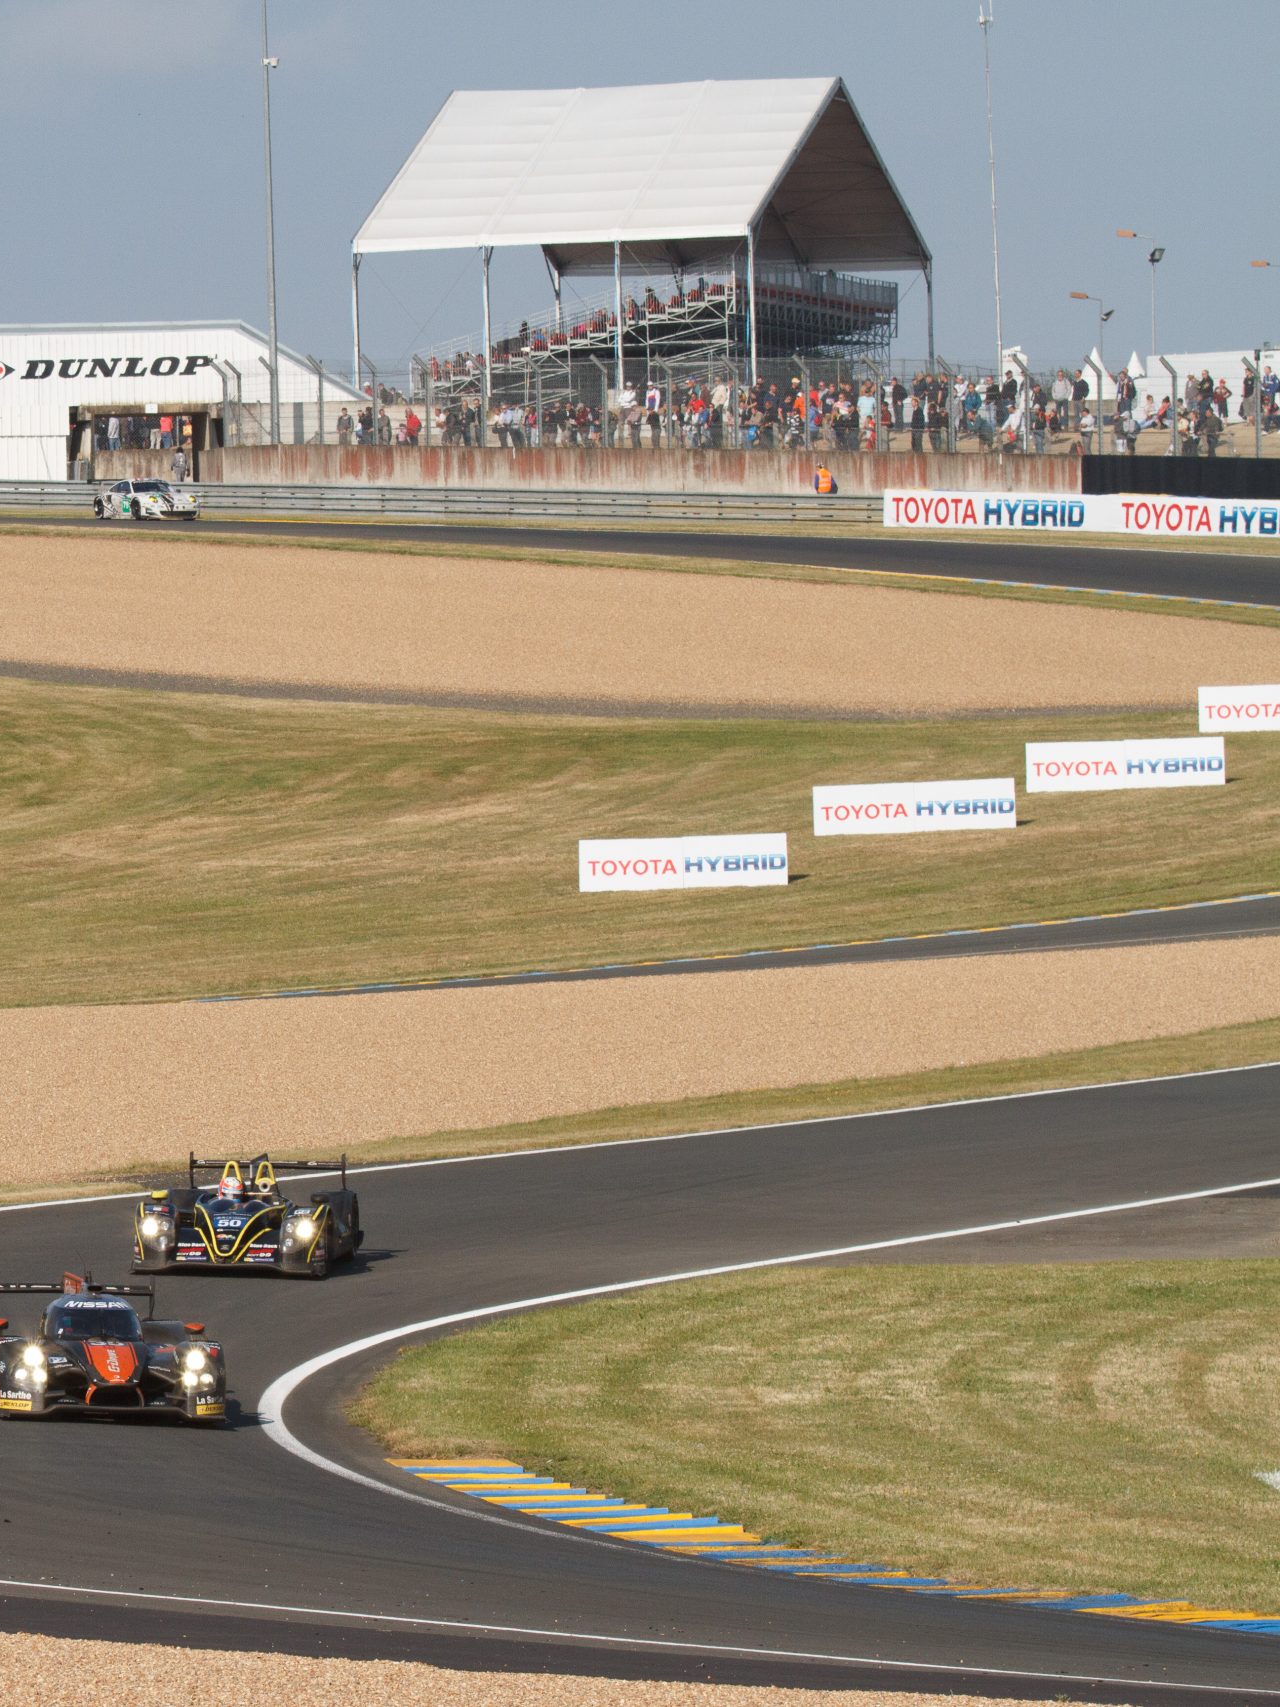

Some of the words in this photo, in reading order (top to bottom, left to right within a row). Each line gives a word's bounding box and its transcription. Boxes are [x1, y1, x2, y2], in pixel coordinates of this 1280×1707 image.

[20, 355, 211, 380] DUNLOP
[892, 497, 977, 525] TOYOTA
[984, 499, 1084, 527] HYBRID
[1121, 502, 1212, 532] TOYOTA
[1219, 505, 1280, 535] HYB
[1204, 703, 1280, 719] TOYOTA
[1033, 761, 1118, 777] TOYOTA
[1126, 756, 1223, 774] HYBRID
[821, 803, 908, 822] TOYOTA
[915, 798, 1015, 816] HYBRID
[587, 859, 677, 877] TOYOTA
[684, 853, 786, 873] HYBRID
[217, 1219, 242, 1227] 50
[64, 1300, 128, 1309] NISSAN
[0, 1389, 6, 1399] La
